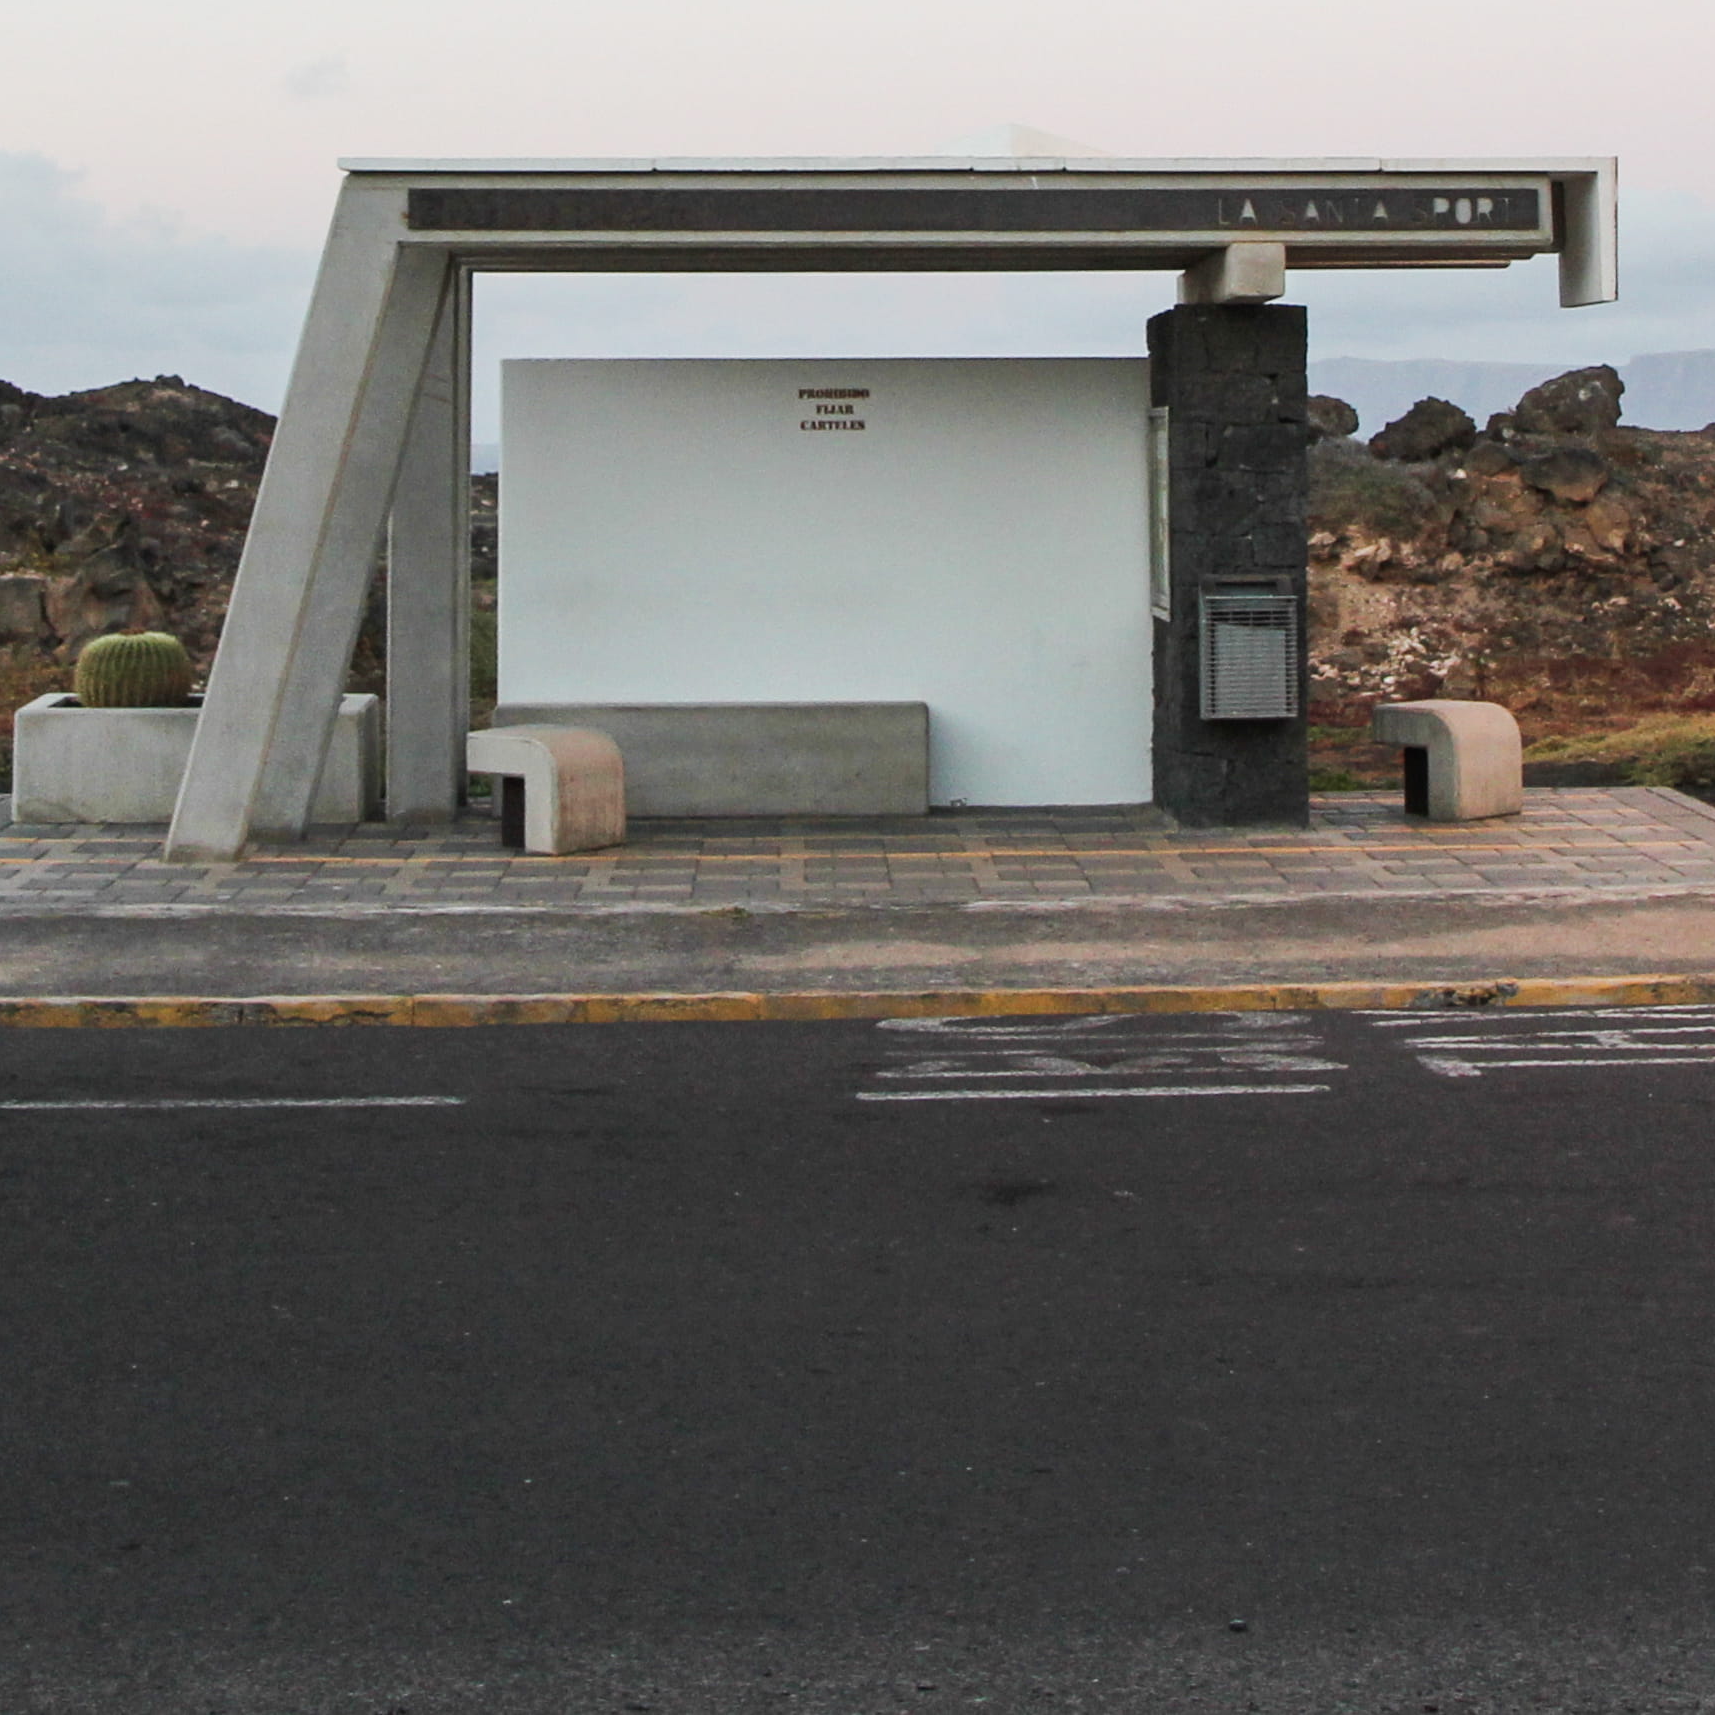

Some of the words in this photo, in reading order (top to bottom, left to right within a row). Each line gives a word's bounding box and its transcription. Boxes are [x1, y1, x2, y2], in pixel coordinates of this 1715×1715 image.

[1218, 197, 1258, 225] LA
[1412, 197, 1513, 225] SPORT
[798, 388, 870, 399] PROHIBIDO
[816, 404, 854, 415] FIJAR
[800, 420, 865, 431] CARTELES
[874, 1009, 1351, 1079] BUS
